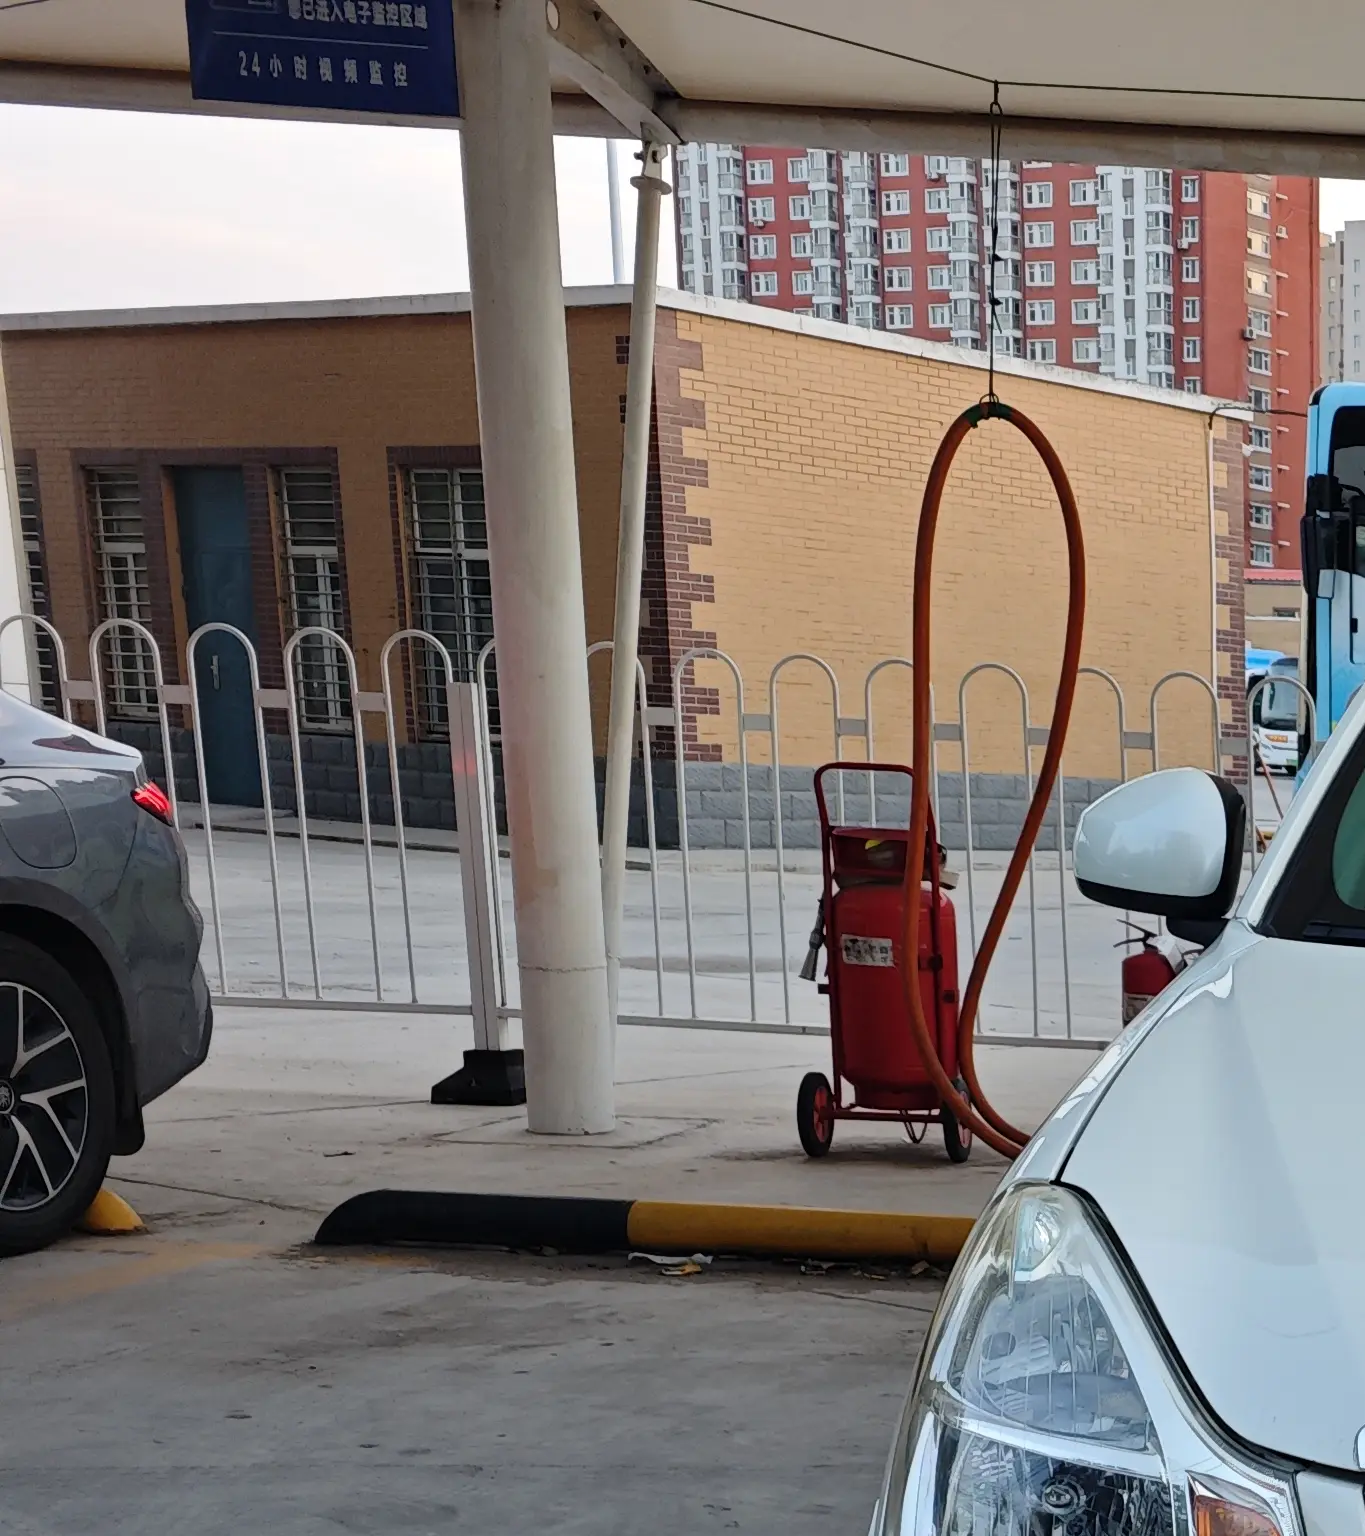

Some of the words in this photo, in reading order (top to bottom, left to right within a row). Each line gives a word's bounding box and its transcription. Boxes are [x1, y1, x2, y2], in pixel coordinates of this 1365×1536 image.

[238, 50, 408, 87] 24小时视频监控
